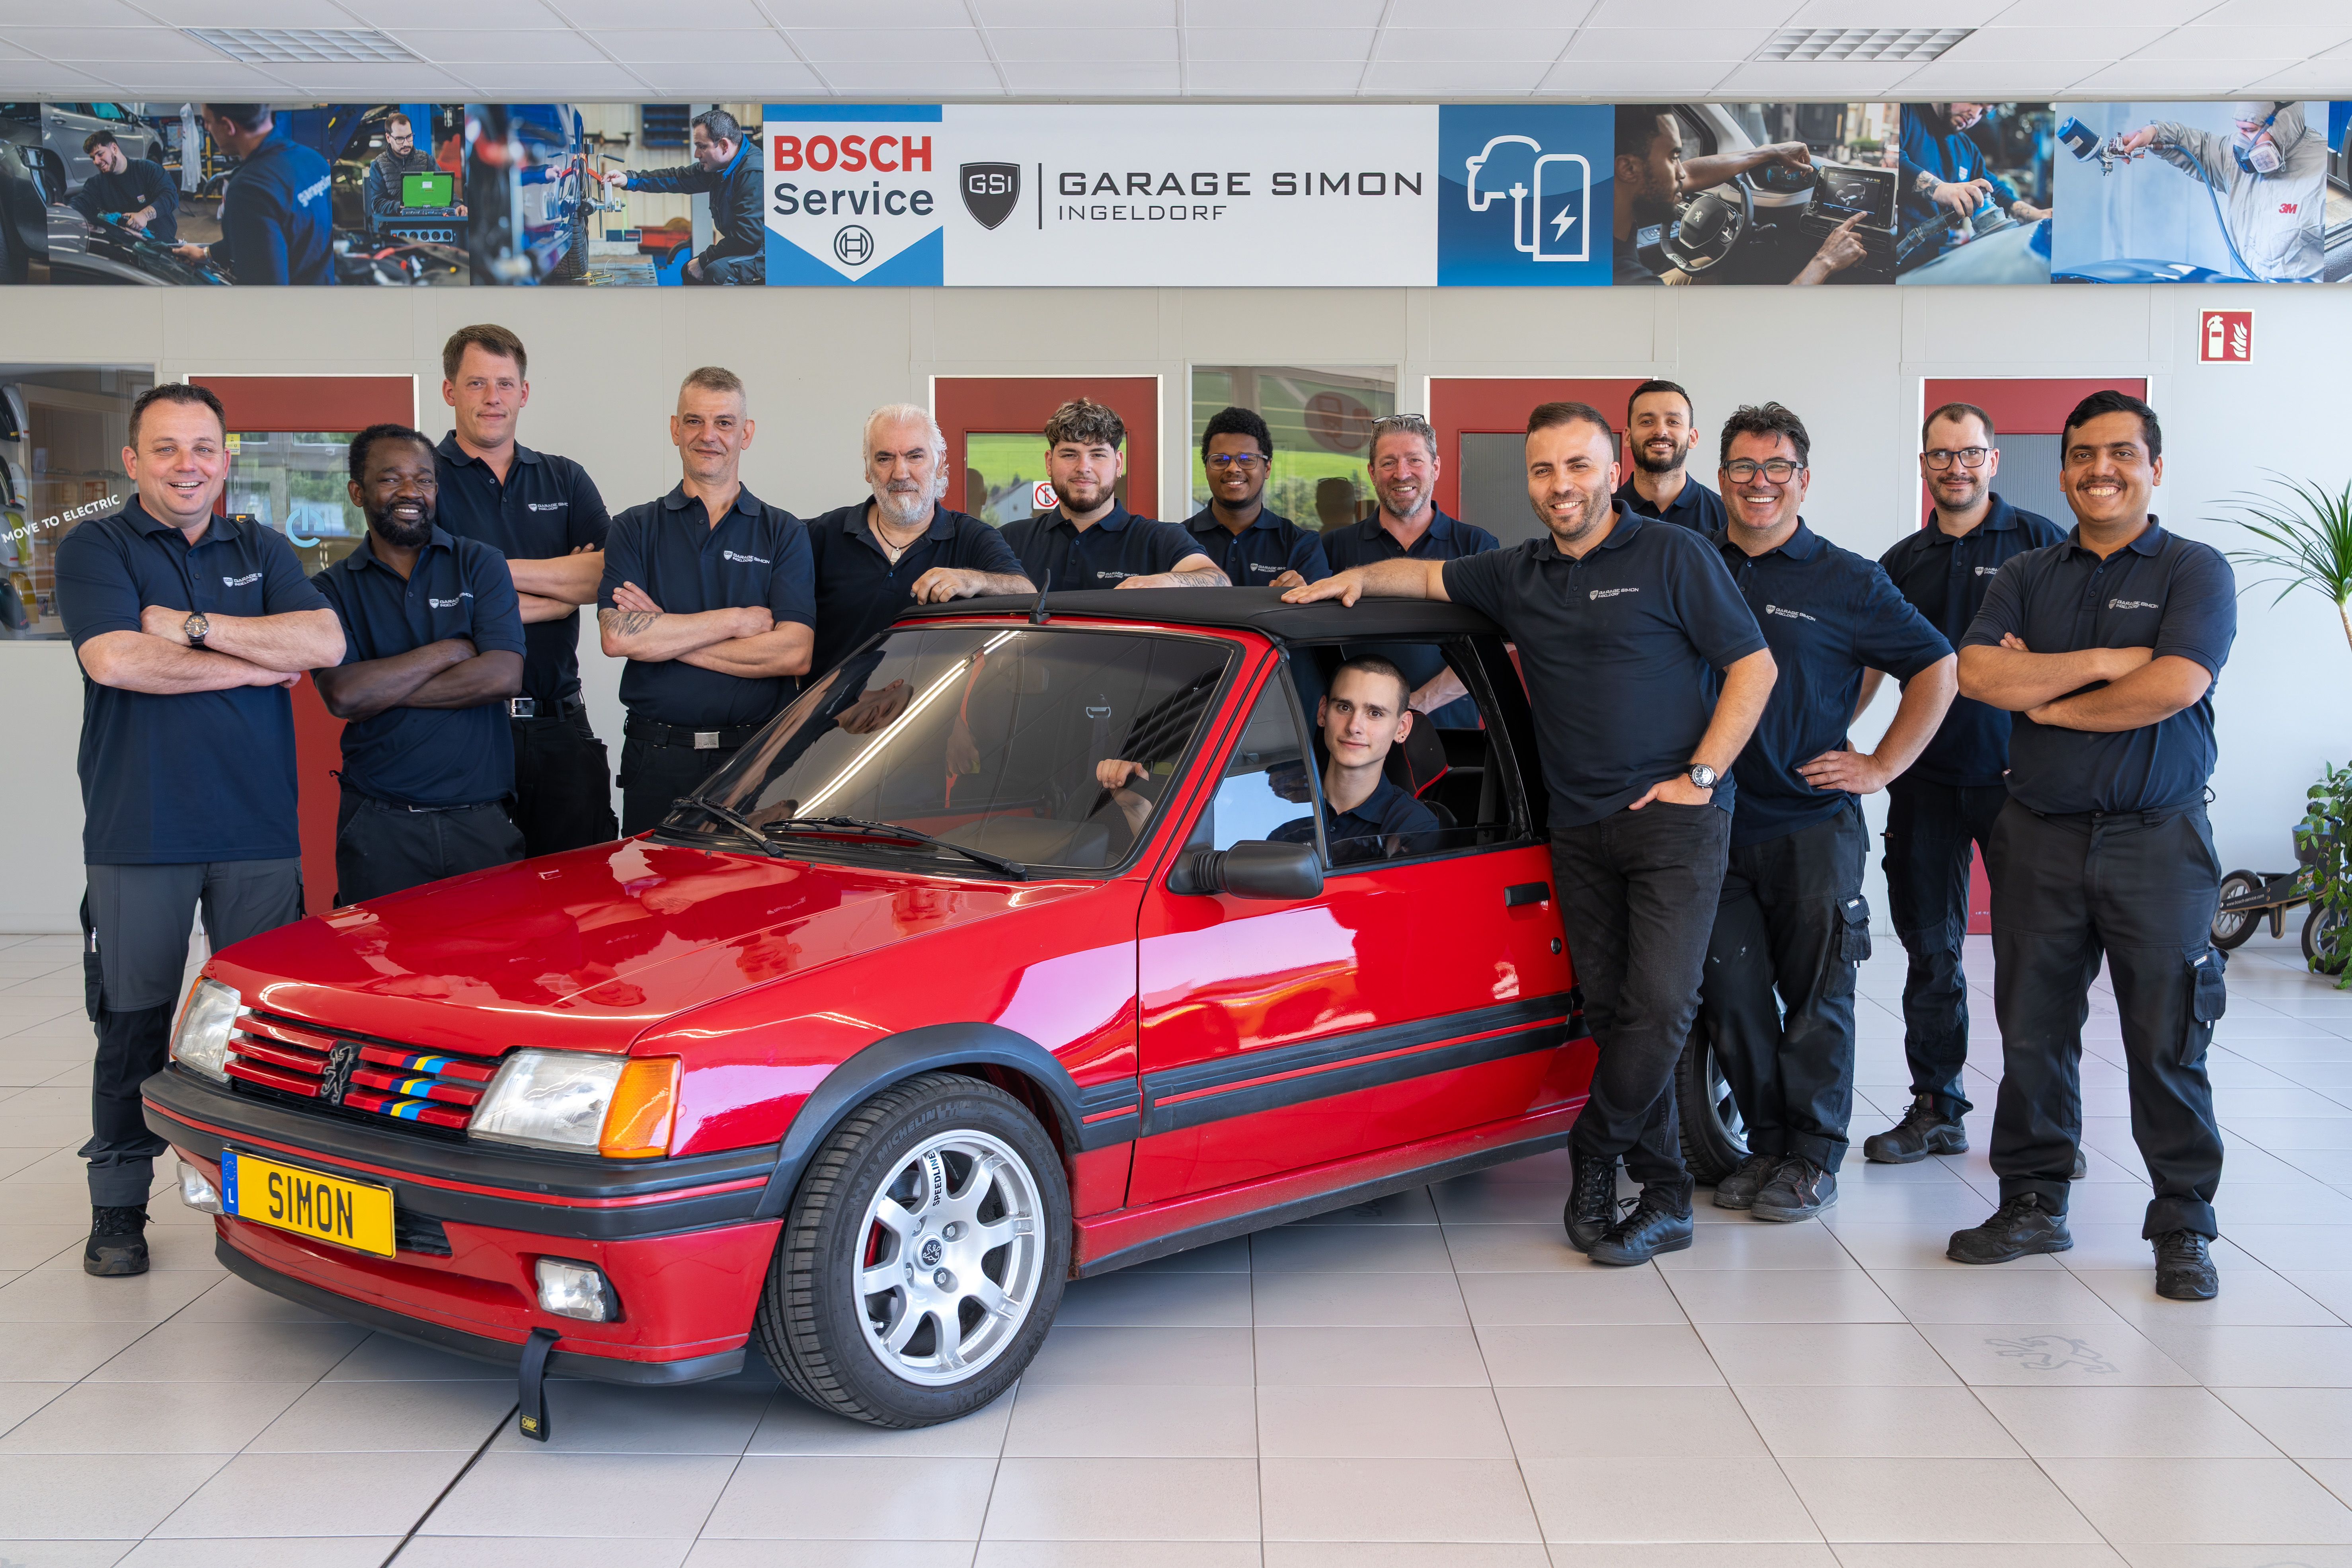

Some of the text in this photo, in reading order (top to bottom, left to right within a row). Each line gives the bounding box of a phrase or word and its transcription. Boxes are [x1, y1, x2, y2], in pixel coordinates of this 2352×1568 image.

[774, 135, 932, 172] BOSCH
[969, 174, 1012, 194] GSI
[1059, 172, 1422, 196] GARAGE SIMON
[773, 181, 934, 216] Service
[2279, 203, 2297, 214] 3M
[1059, 205, 1227, 220] INGELDORF
[2, 494, 120, 543] MOVE TO ELECTRIC
[234, 573, 257, 583] GARAGE
[1799, 612, 1816, 622] SIMON
[877, 1108, 936, 1163] MICHELIN
[928, 1152, 942, 1207] SPEEDLINE
[228, 1188, 234, 1204] L
[269, 1172, 353, 1239] SIMON
[522, 1417, 537, 1429] OMP
